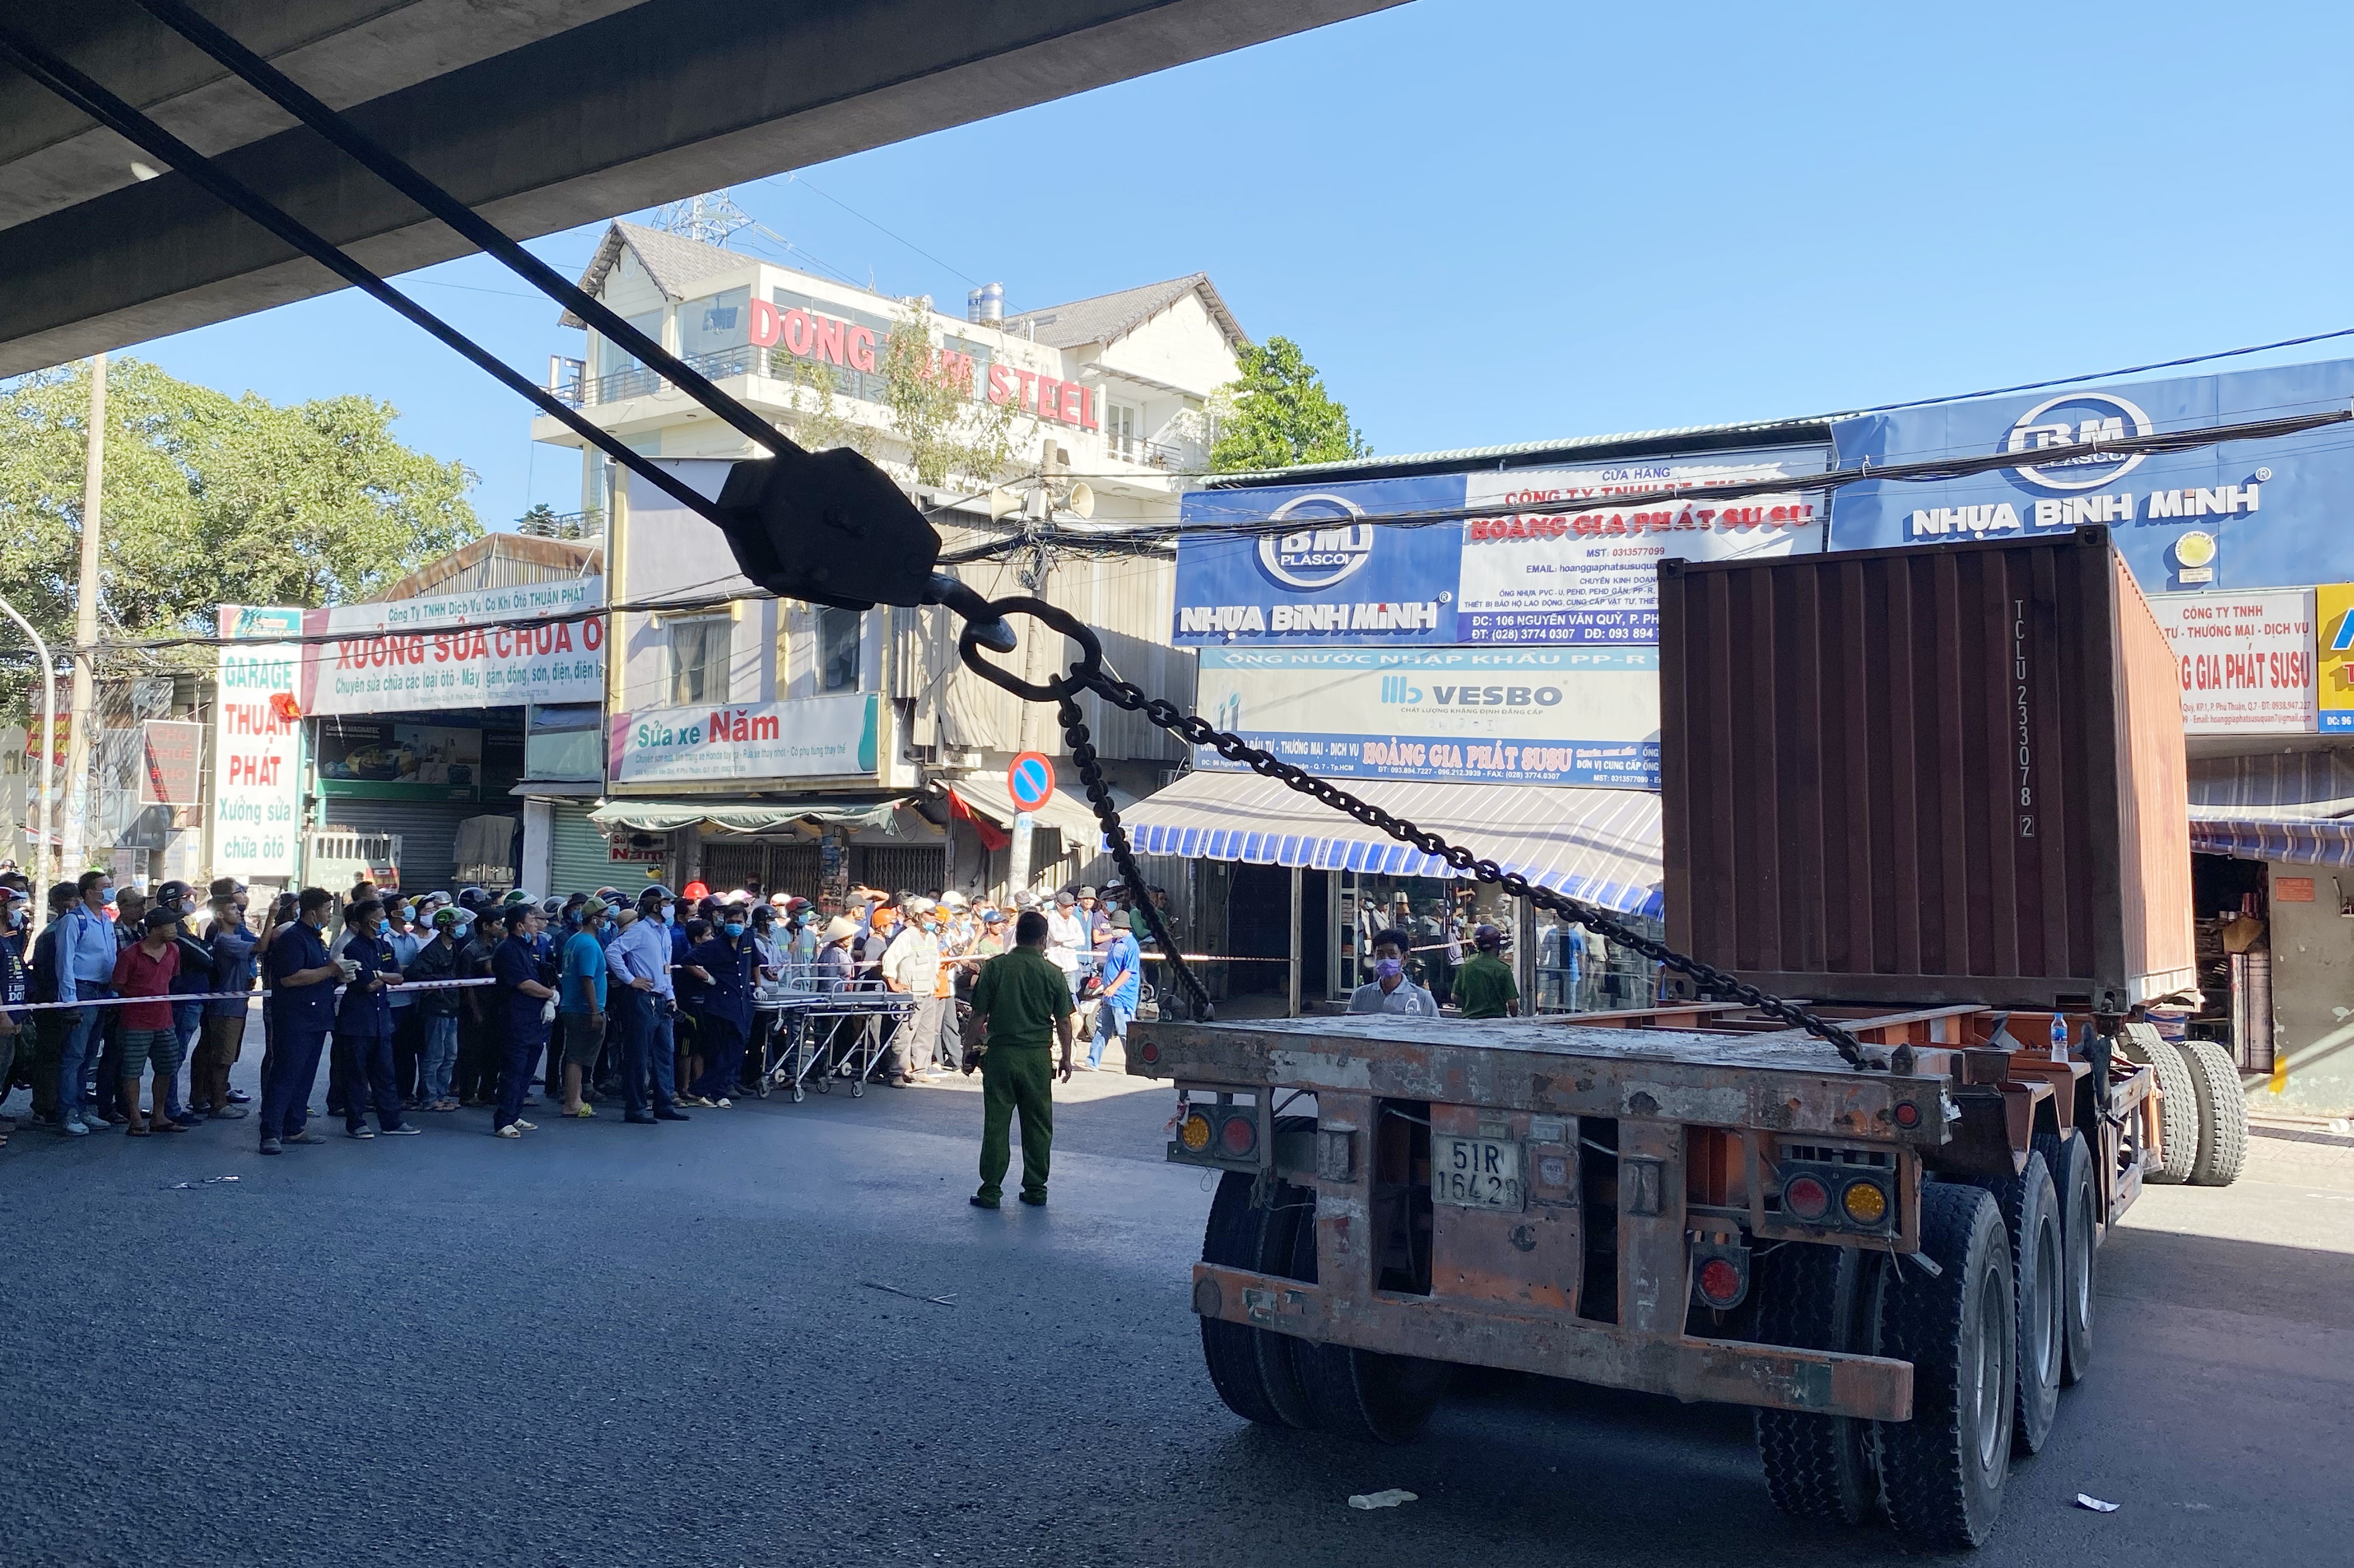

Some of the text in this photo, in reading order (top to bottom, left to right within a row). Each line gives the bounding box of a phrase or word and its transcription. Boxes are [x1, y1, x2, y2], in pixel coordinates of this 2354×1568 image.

[987, 363, 1099, 429] STEEL
[1602, 465, 1670, 481] CỬA HÀNG
[1471, 514, 1568, 540] HOÀNG
[1572, 513, 1627, 535] GIA
[1633, 503, 1716, 532] PHÁT
[1913, 503, 2020, 539] NHỰA
[1586, 547, 1665, 557] MST: 0313577099
[1526, 565, 1558, 573] EMAIL:
[388, 608, 408, 622] Công
[410, 606, 420, 621] Ty
[423, 602, 446, 617] TNHH
[449, 600, 467, 618] Dịch
[470, 599, 481, 616] Vụ
[498, 595, 511, 609] Khí
[530, 587, 559, 608] THUẬN
[562, 583, 585, 603] PHÁT
[2183, 605, 2263, 620] CÔNG TY TNHH
[1180, 605, 1265, 640] NHỰA
[1472, 616, 1492, 626] ĐC:
[1495, 615, 1514, 625] 106
[1517, 612, 1565, 625] NGUYỄN
[1568, 612, 1593, 625] VĂN
[2188, 623, 2231, 638] THƯƠNG
[2235, 625, 2254, 640] MẠI
[2265, 622, 2290, 639] DỊCH
[2294, 622, 2308, 637] VỤ
[1492, 629, 1518, 641] (028)
[1521, 629, 1546, 639] 3774
[1549, 628, 1575, 638] 0307
[1608, 628, 1629, 638] 093
[1632, 628, 1653, 638] 894
[2015, 600, 2026, 680] TCLU
[1291, 653, 1371, 664] NƯỚC
[1380, 653, 1468, 666] NHẬP
[1471, 651, 1561, 664] KHẨU
[2196, 643, 2311, 691] GIA PHÁT SUSU
[225, 656, 293, 689] GARAGE
[336, 677, 364, 696] Chuyên
[406, 671, 420, 689] các
[423, 670, 438, 692] loại
[462, 667, 480, 689] Máy
[1432, 686, 1563, 706] VESBO
[638, 709, 779, 747] Sửa xe Năm
[1281, 740, 1308, 754] THƯƠNG
[1310, 741, 1323, 759] MẠI
[1330, 743, 1347, 759] DỊCH
[1349, 743, 1359, 760] VỤ
[1363, 737, 1573, 772] HOÀNG GIA PHÁT SUSU
[2017, 685, 2031, 806] 233078
[229, 748, 281, 786] PHÁT
[1330, 764, 1354, 772] Tp.HCM
[1390, 766, 1432, 775] 093.894.7227
[1437, 768, 1481, 777] 096.212.3939
[1505, 771, 1523, 779] (028)
[1524, 772, 1561, 780] 3774.0307
[1603, 761, 1624, 770] CUNG
[219, 795, 291, 826] Xưởng sửa
[2022, 817, 2032, 837] 2
[224, 835, 284, 859] chữa ôtô
[1453, 1141, 1499, 1173] 51R
